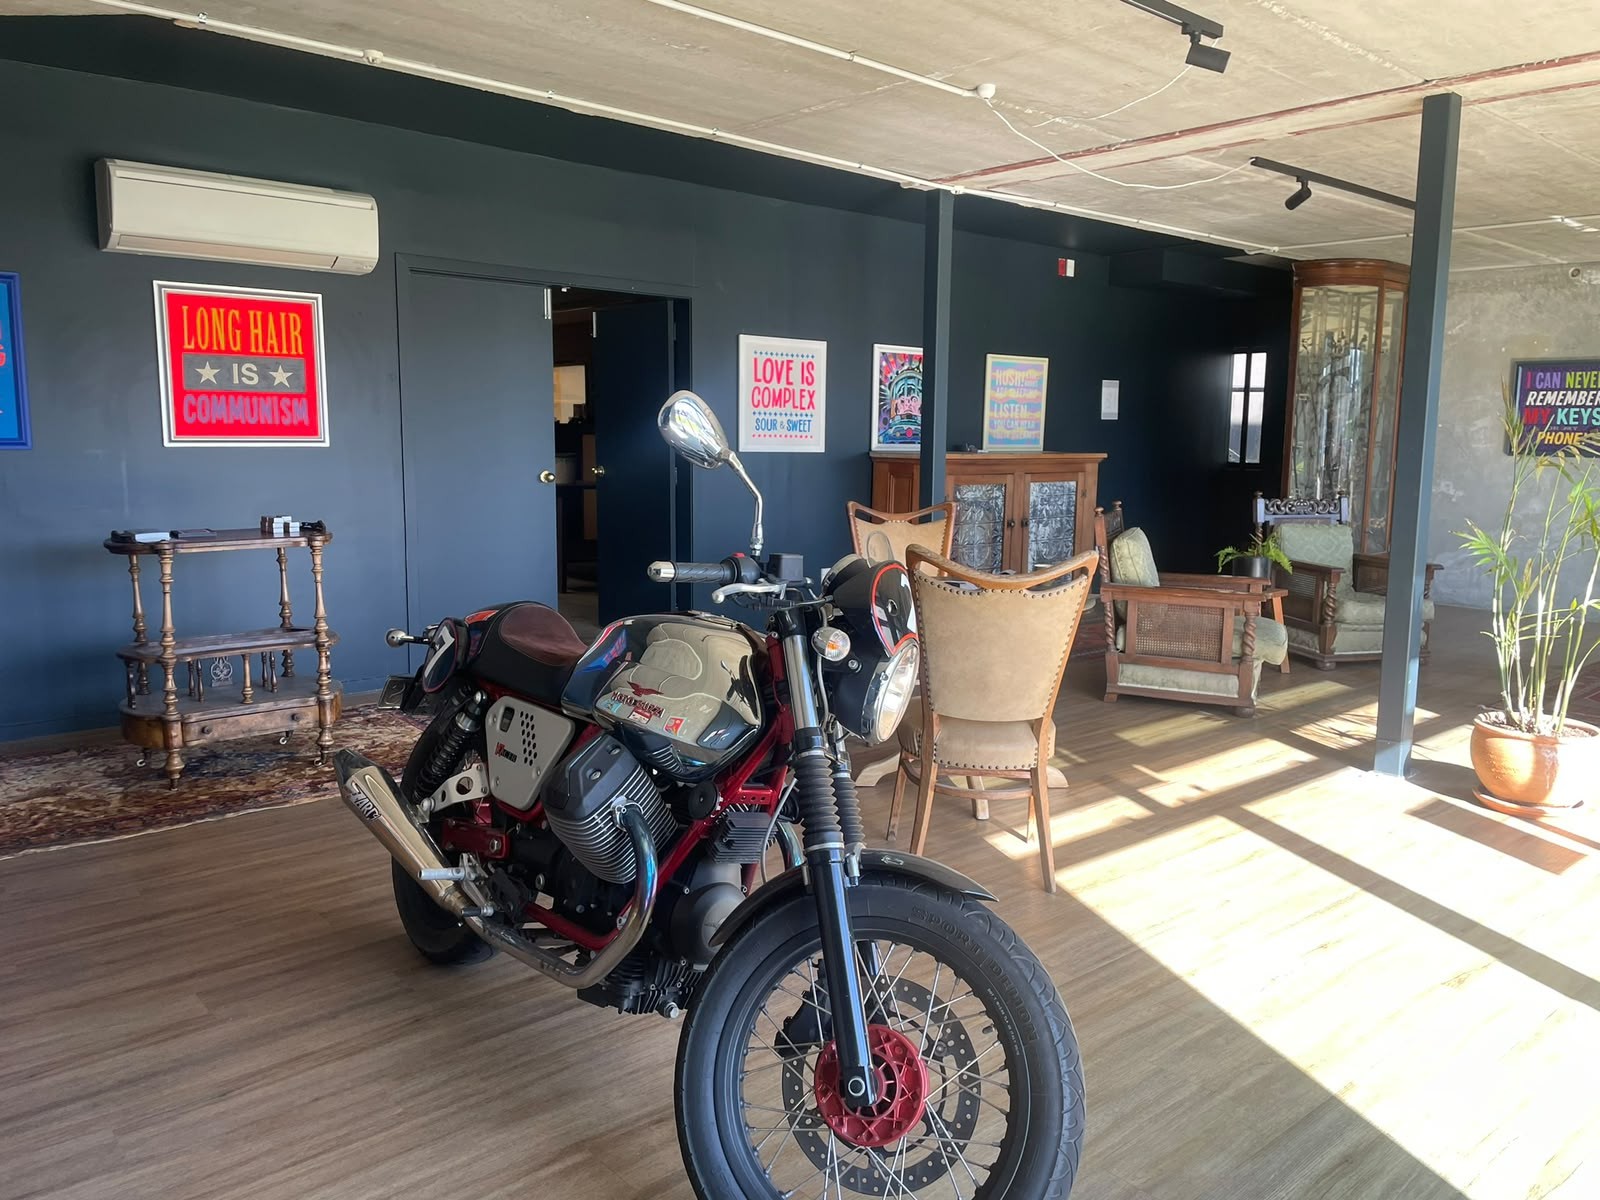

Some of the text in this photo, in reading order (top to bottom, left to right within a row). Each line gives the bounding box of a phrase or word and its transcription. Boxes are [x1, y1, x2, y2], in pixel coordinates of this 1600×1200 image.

[182, 305, 304, 355] LONG HAIR
[232, 363, 259, 385] IS
[753, 357, 815, 387] LOVE IS
[1525, 370, 1600, 389] I CAN NEVE
[183, 394, 310, 427] COMMUNISM
[751, 386, 816, 411] COMPLEX
[755, 417, 812, 432] SOUR & SWEET
[1524, 407, 1600, 426] MY KEYS
[912, 905, 1038, 1042] SPORT DEMON
